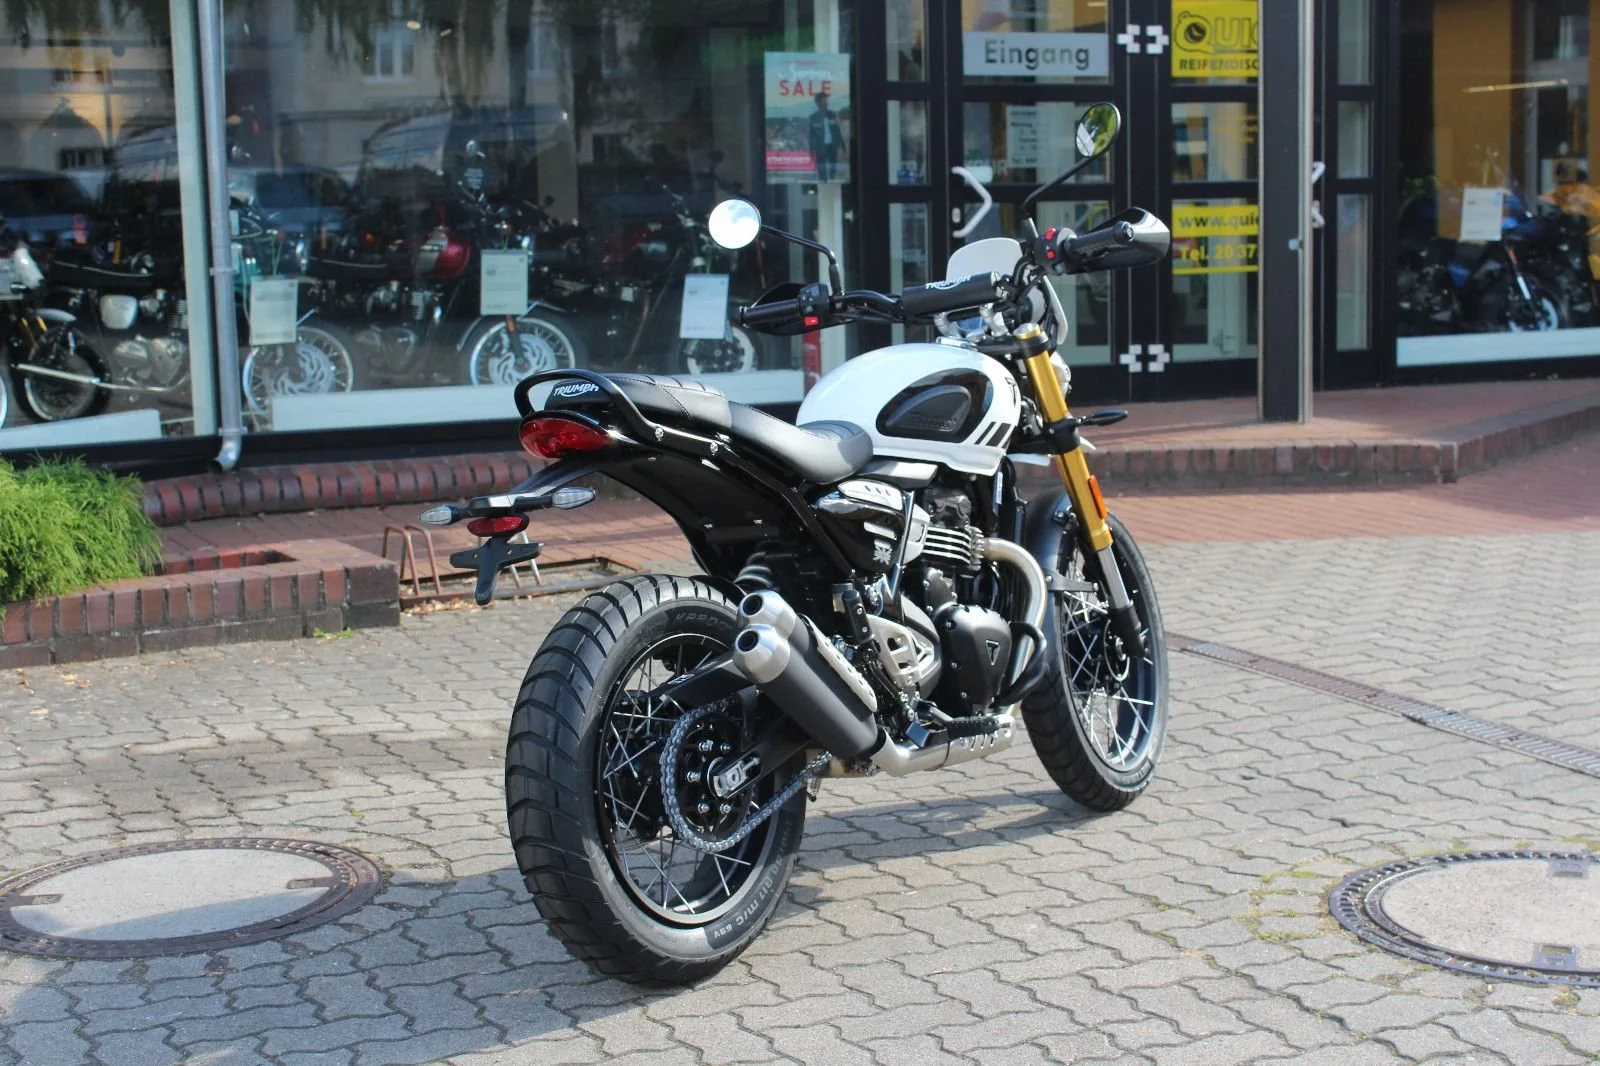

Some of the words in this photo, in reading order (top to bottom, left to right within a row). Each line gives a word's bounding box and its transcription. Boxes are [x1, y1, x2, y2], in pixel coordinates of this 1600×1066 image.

[1175, 11, 1258, 54] QUI
[984, 39, 1090, 70] Eingang
[779, 79, 832, 97] SALE
